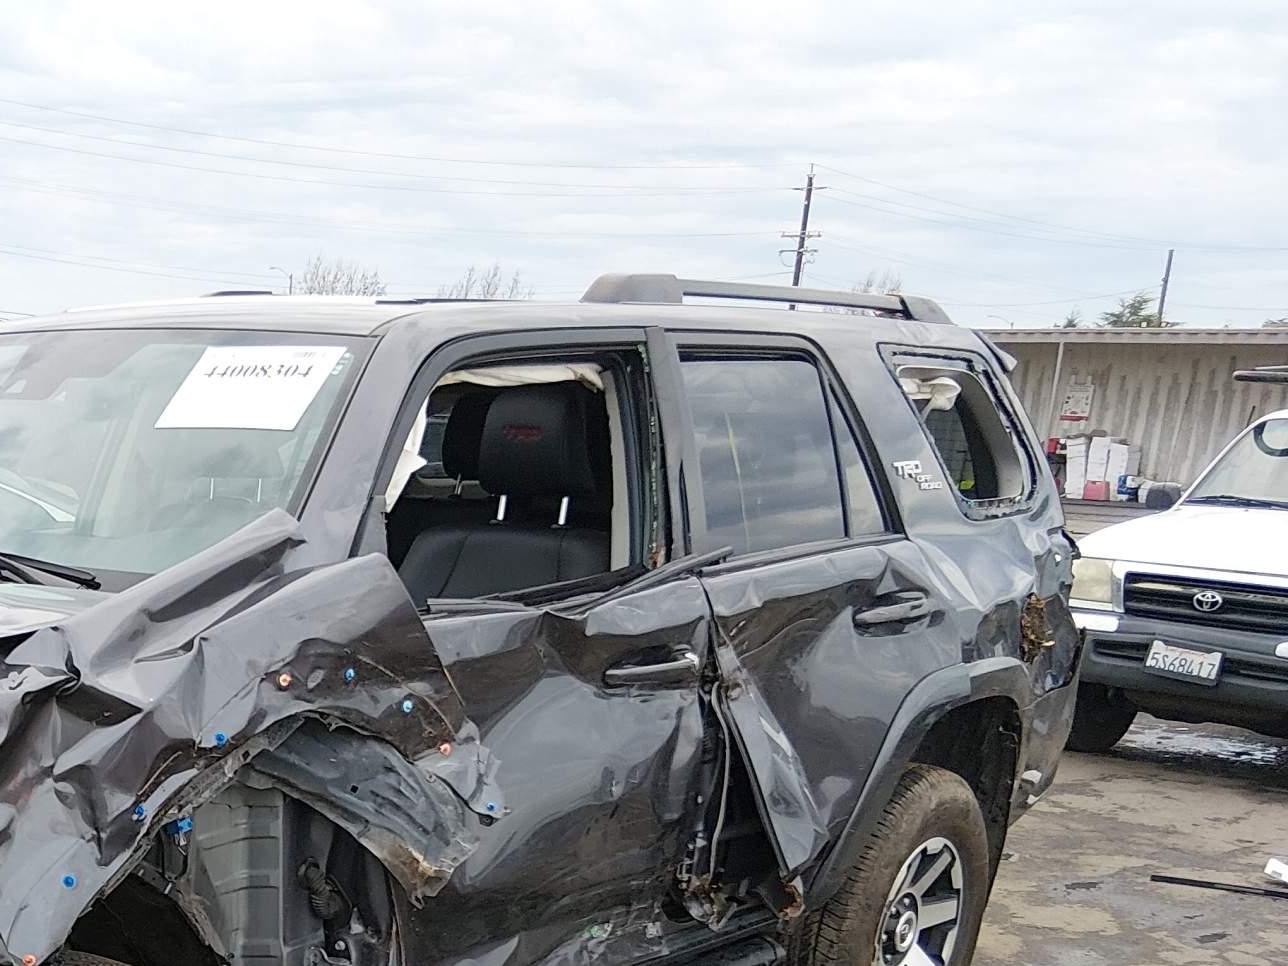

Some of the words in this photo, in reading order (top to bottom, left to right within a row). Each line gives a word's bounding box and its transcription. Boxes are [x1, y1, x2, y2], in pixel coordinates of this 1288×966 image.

[203, 364, 314, 378] 44008304
[892, 460, 922, 478] TRD
[920, 481, 943, 490] ROAD
